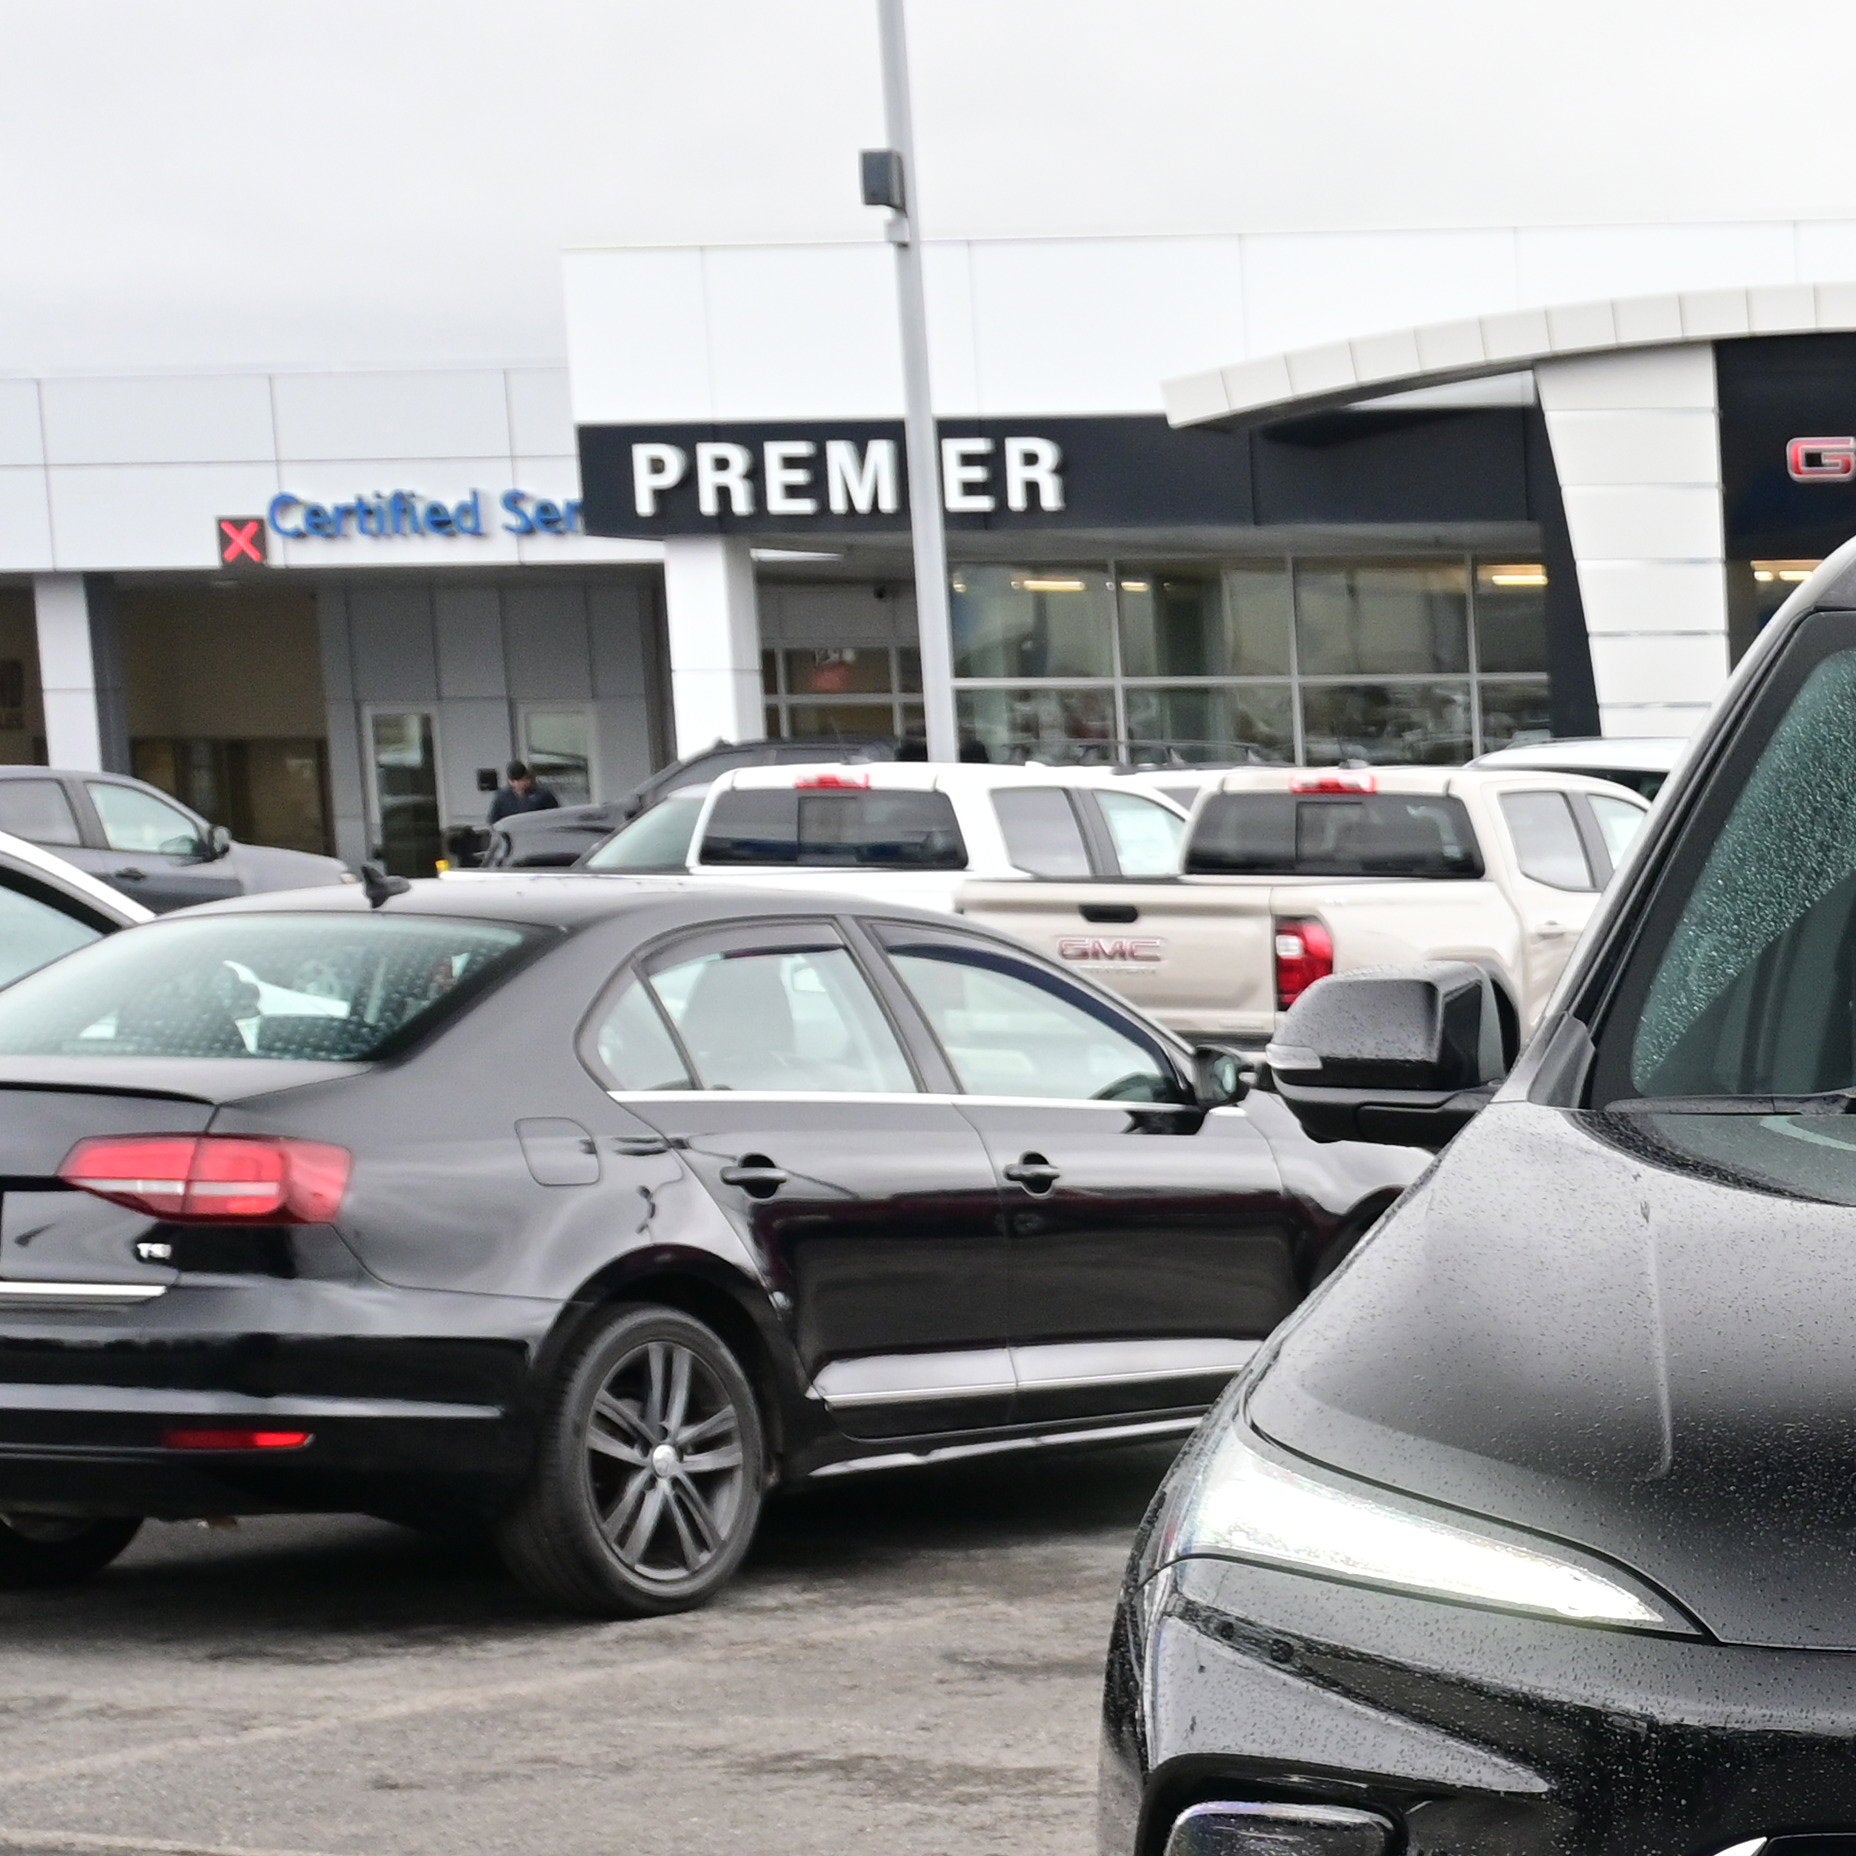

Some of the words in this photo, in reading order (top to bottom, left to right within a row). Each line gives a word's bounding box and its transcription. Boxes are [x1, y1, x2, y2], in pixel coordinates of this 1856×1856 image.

[631, 436, 1066, 517] PREMER
[268, 488, 486, 540] Certified
[1058, 938, 1162, 961] GMC
